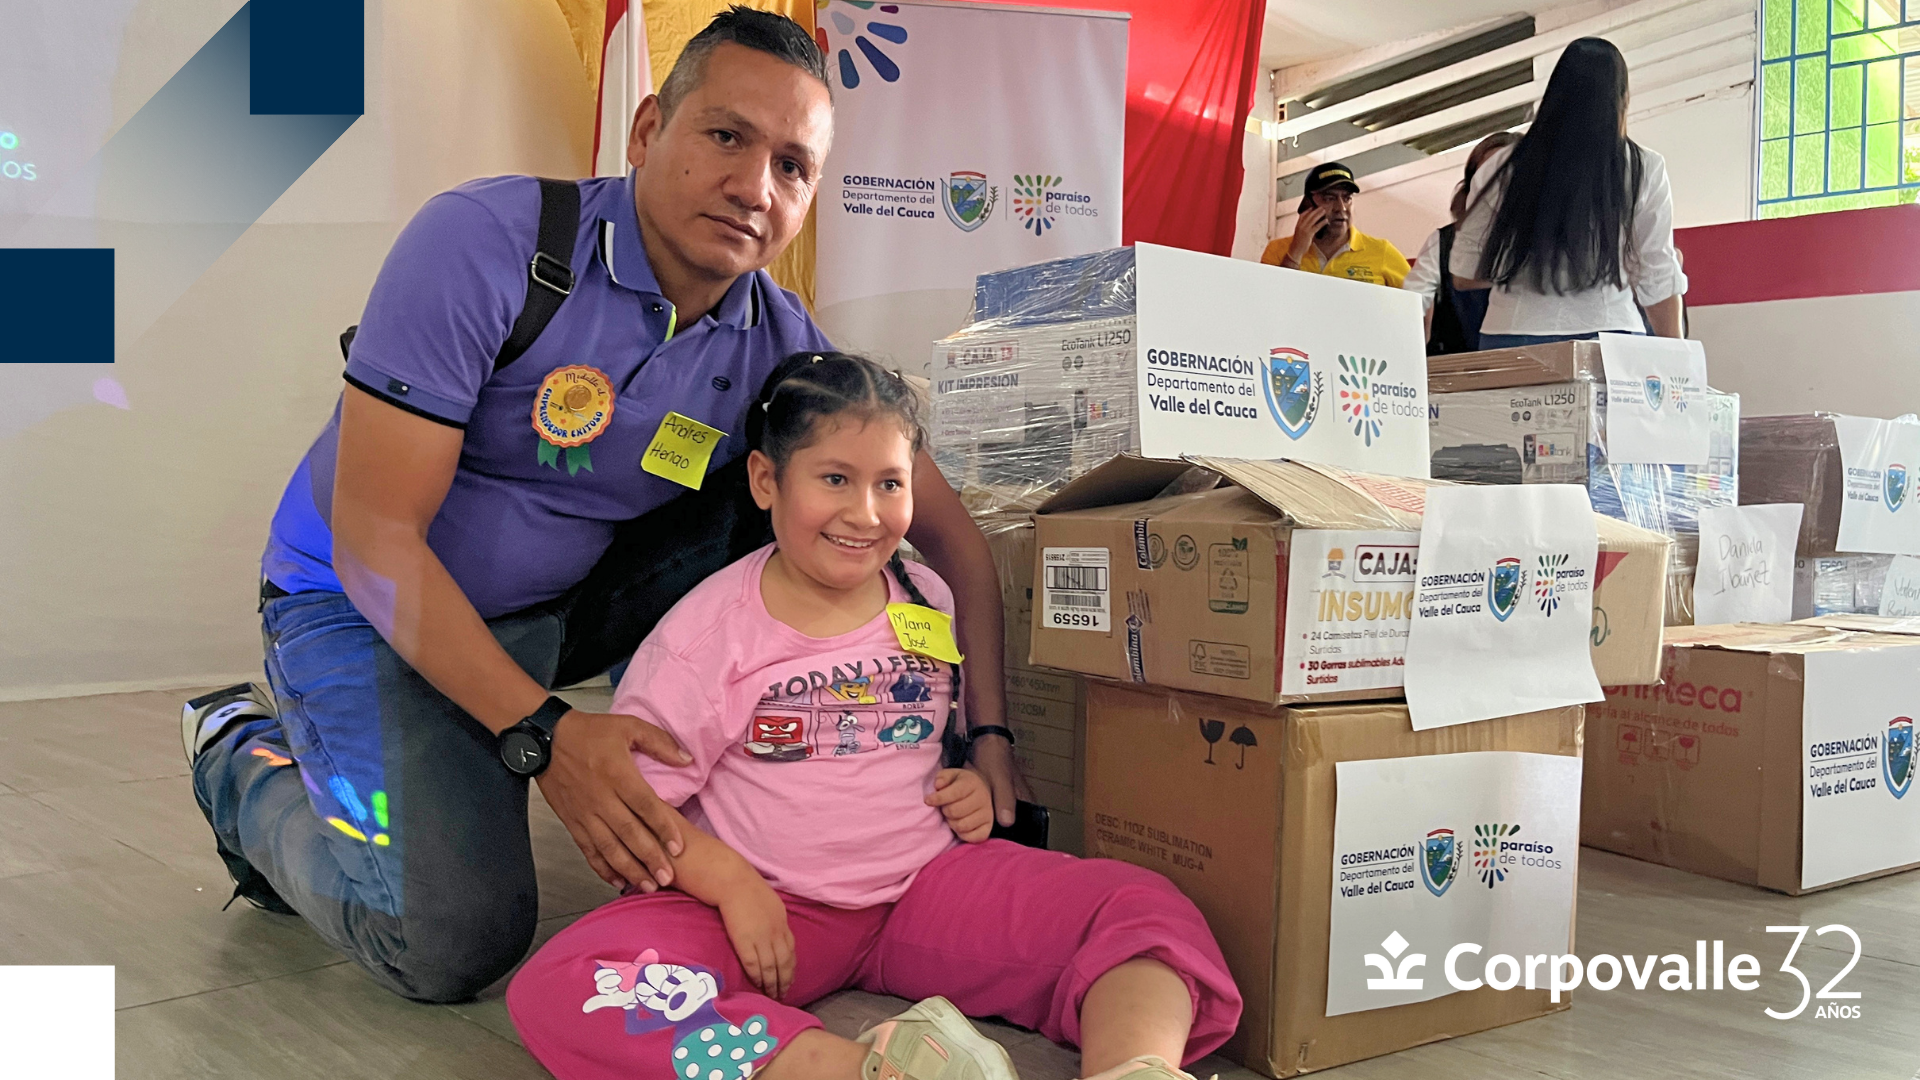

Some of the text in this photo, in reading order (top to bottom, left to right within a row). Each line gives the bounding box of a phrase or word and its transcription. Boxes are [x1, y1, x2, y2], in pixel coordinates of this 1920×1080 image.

[1, 160, 37, 181] os
[843, 175, 935, 190] GOBERNACIÓN
[842, 190, 935, 204] Departamento del
[1046, 191, 1091, 203] paraíso
[843, 203, 935, 218] Valle del Cauca
[1045, 202, 1098, 217] de todos
[1061, 329, 1131, 351] EcoTank L1250
[1147, 348, 1254, 375] GOBERNACIÓN
[937, 379, 955, 394] KIT
[1147, 372, 1256, 397] Departamento del
[1372, 382, 1417, 399] paraíso
[1149, 394, 1185, 413] Valle
[1189, 397, 1211, 415] del
[1214, 400, 1258, 419] Cauca
[1373, 397, 1425, 418] de todos
[1510, 393, 1576, 408] EcoTank L1250
[1359, 552, 1417, 575] CAJA:
[1421, 569, 1485, 587] GOBERNACIÓN
[1556, 567, 1585, 581] paraíso
[1555, 580, 1588, 592] de todos
[1419, 588, 1483, 603] Departamento del
[1053, 612, 1099, 627] 16559
[1419, 603, 1481, 618] Valle del Cauca
[1311, 631, 1321, 640] 24
[1323, 630, 1362, 640] Camisetas
[1363, 629, 1378, 638] Piel
[1379, 629, 1388, 638] de
[1131, 634, 1144, 682] olombina
[1310, 645, 1342, 654] Surtidas
[1308, 661, 1319, 671] 30
[1321, 660, 1347, 670] Gorras
[1348, 657, 1391, 669] sublimables
[769, 654, 940, 700] TODAY I FEEL
[1307, 674, 1338, 685] Surtidas
[1683, 717, 1699, 730] de
[1702, 721, 1739, 737] todos
[1810, 733, 1878, 758] GOBERNACIÓN
[1810, 756, 1877, 779] Departamento del
[1810, 777, 1876, 798] Valle del Cauca
[1097, 829, 1204, 872] CERAMIC WHITE MUG-A
[1147, 826, 1213, 859] SUBLIMATION
[1500, 840, 1554, 854] paraíso
[1341, 843, 1415, 865] GOBERNACIÓN
[1499, 852, 1562, 870] de todos
[1340, 862, 1415, 882] Departamento del
[1340, 878, 1414, 898] Valle del Cauca
